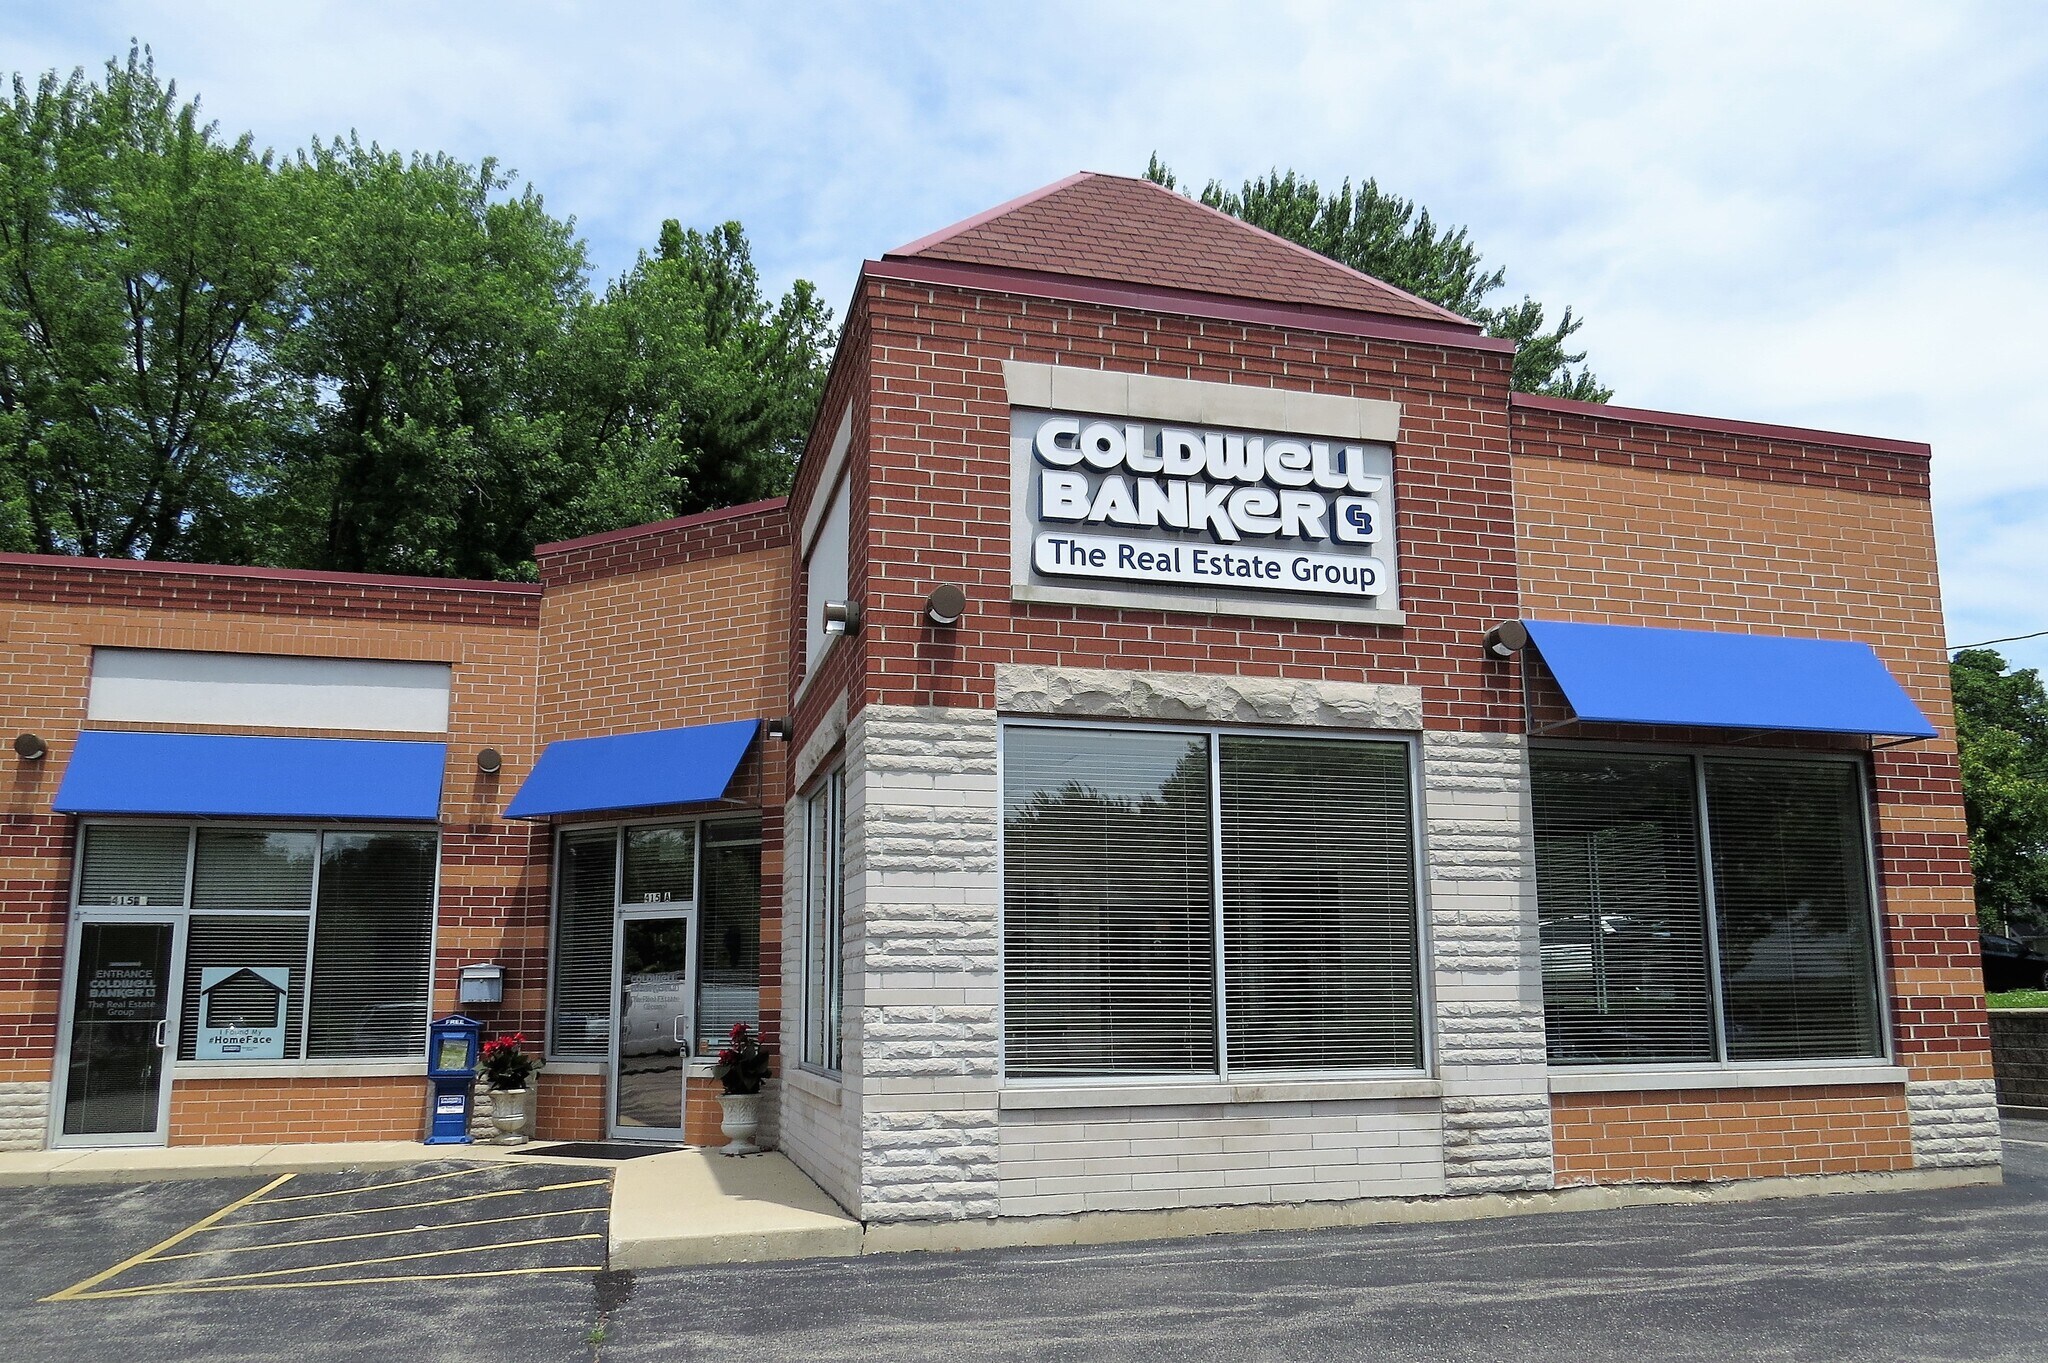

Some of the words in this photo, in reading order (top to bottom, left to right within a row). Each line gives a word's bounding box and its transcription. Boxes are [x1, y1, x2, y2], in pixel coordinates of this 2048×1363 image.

[1034, 418, 1384, 493] COLDWELL
[1039, 469, 1329, 542] BANKER
[1048, 538, 1107, 568] The
[1118, 544, 1181, 573] Real
[1192, 549, 1282, 579] Estate
[1291, 556, 1376, 591] Group
[111, 895, 134, 905] 415
[96, 969, 153, 978] ENTRANCE
[88, 1000, 104, 1008] The
[107, 1000, 126, 1008] Real
[128, 1000, 156, 1008] Estate
[108, 1008, 135, 1017] Group
[209, 1036, 272, 1044] #HomeFace
